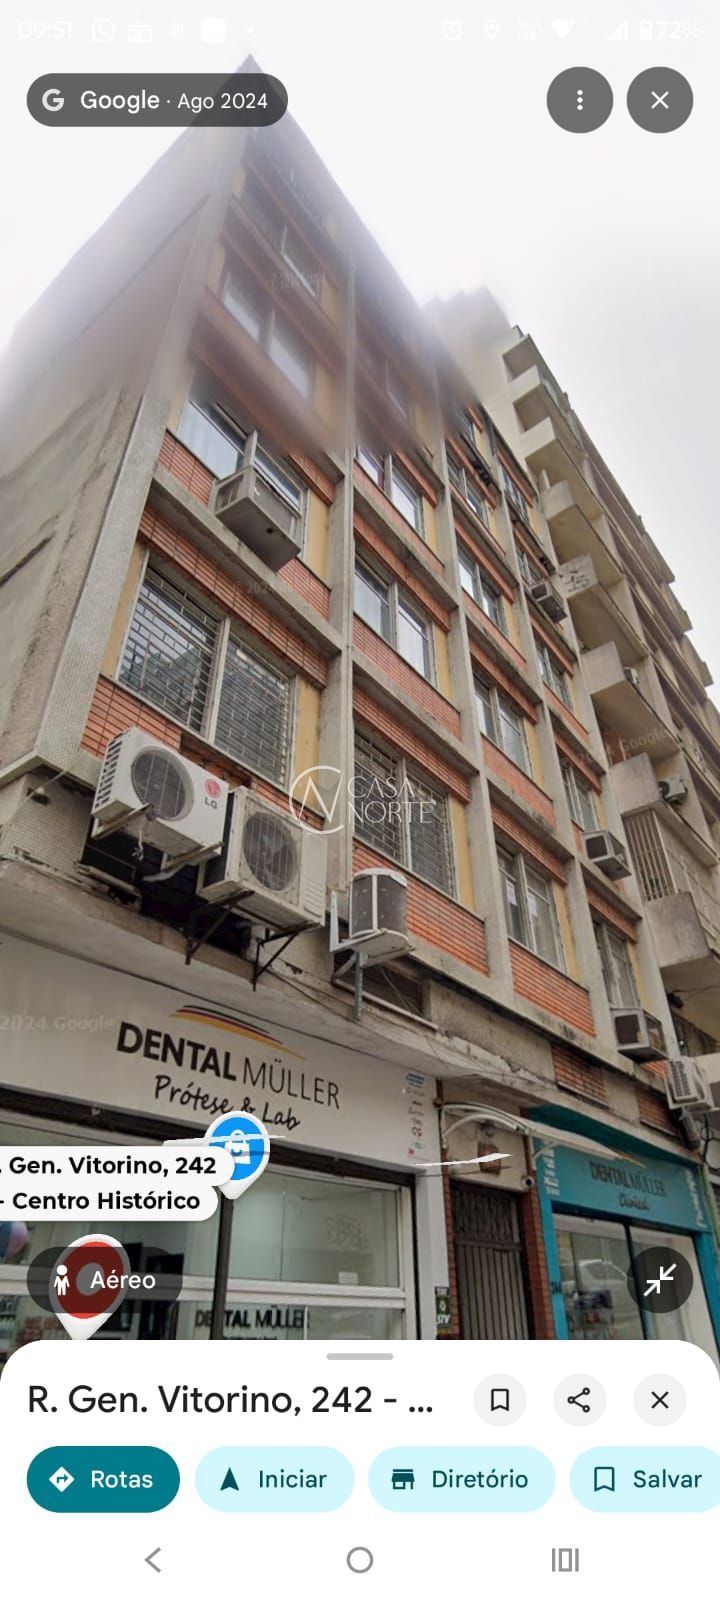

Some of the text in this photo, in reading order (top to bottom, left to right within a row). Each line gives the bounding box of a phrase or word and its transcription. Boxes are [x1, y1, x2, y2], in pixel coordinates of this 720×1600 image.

[204, 796, 219, 810] LG
[116, 1021, 237, 1082] DENTAL
[243, 1057, 341, 1110] MÜLLER
[154, 1074, 234, 1115] Prótese
[262, 1101, 301, 1131] Lab
[589, 1160, 632, 1188] DENTAL
[194, 1309, 251, 1329] DETAL
